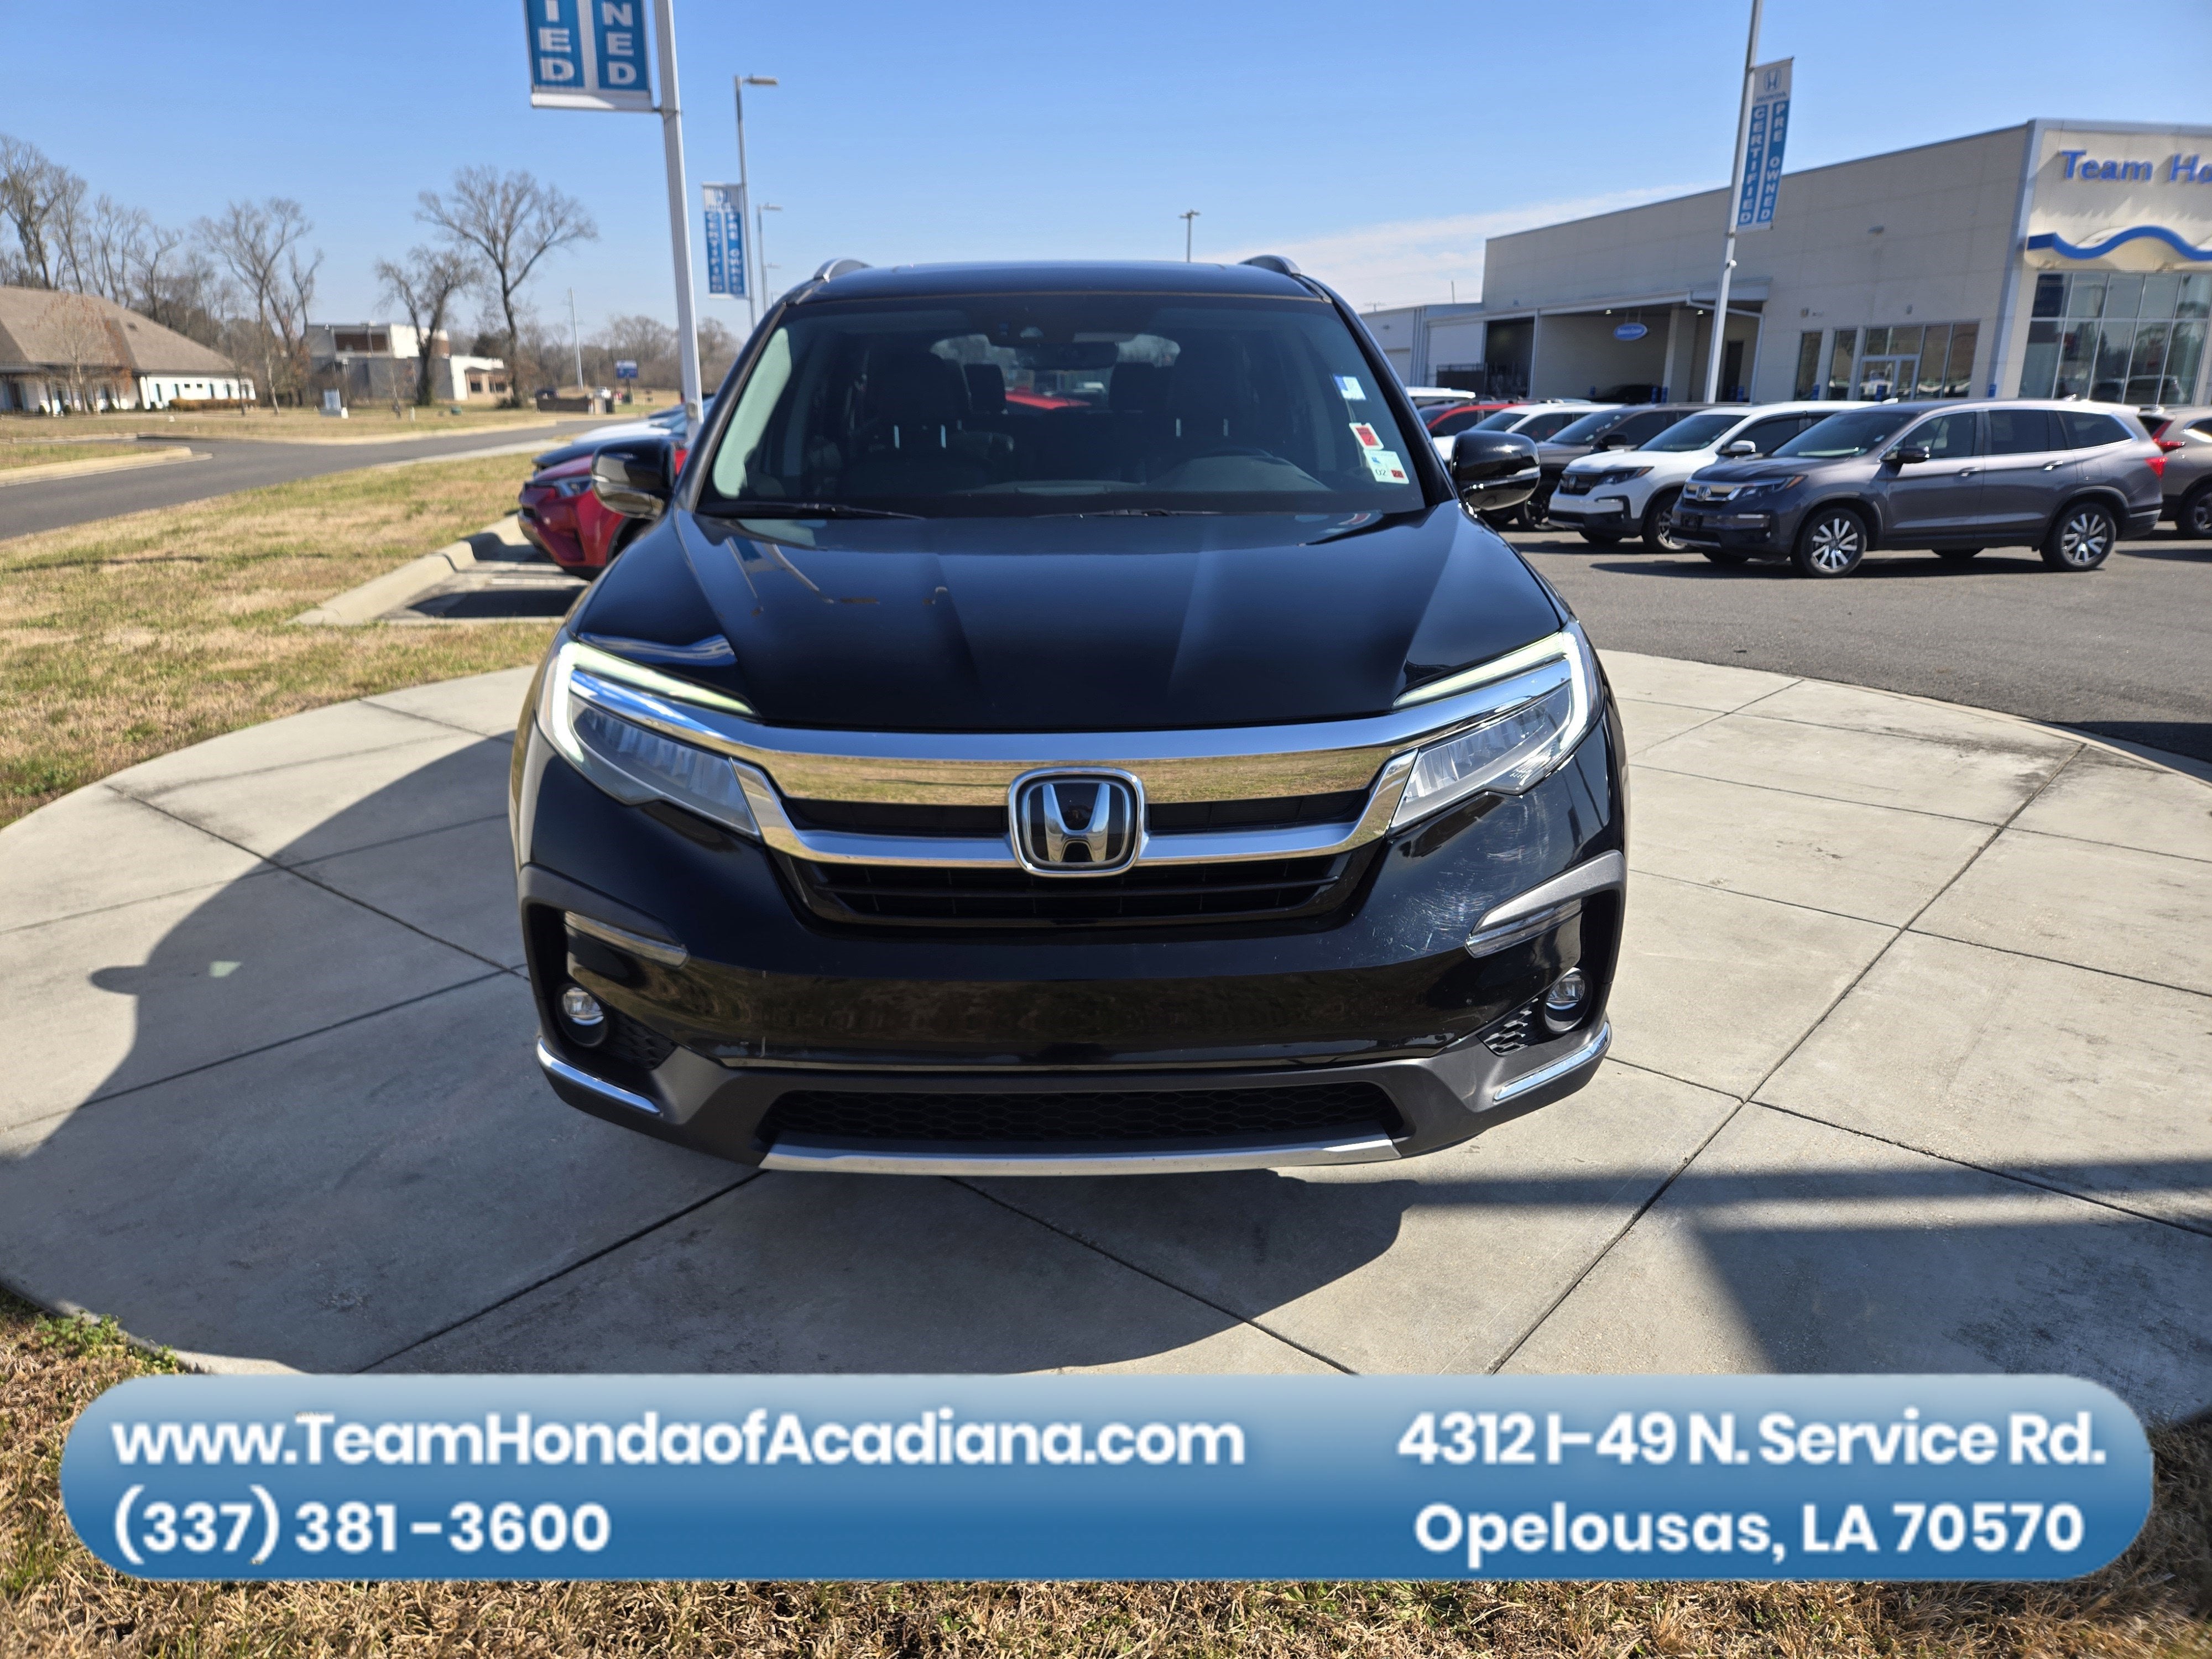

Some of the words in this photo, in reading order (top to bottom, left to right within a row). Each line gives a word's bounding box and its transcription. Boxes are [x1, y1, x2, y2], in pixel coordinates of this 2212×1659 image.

[1773, 103, 1786, 143] PRE
[1740, 107, 1766, 223] CERTIFIED
[1760, 155, 1780, 220] OWNED
[2061, 149, 2153, 181] Team
